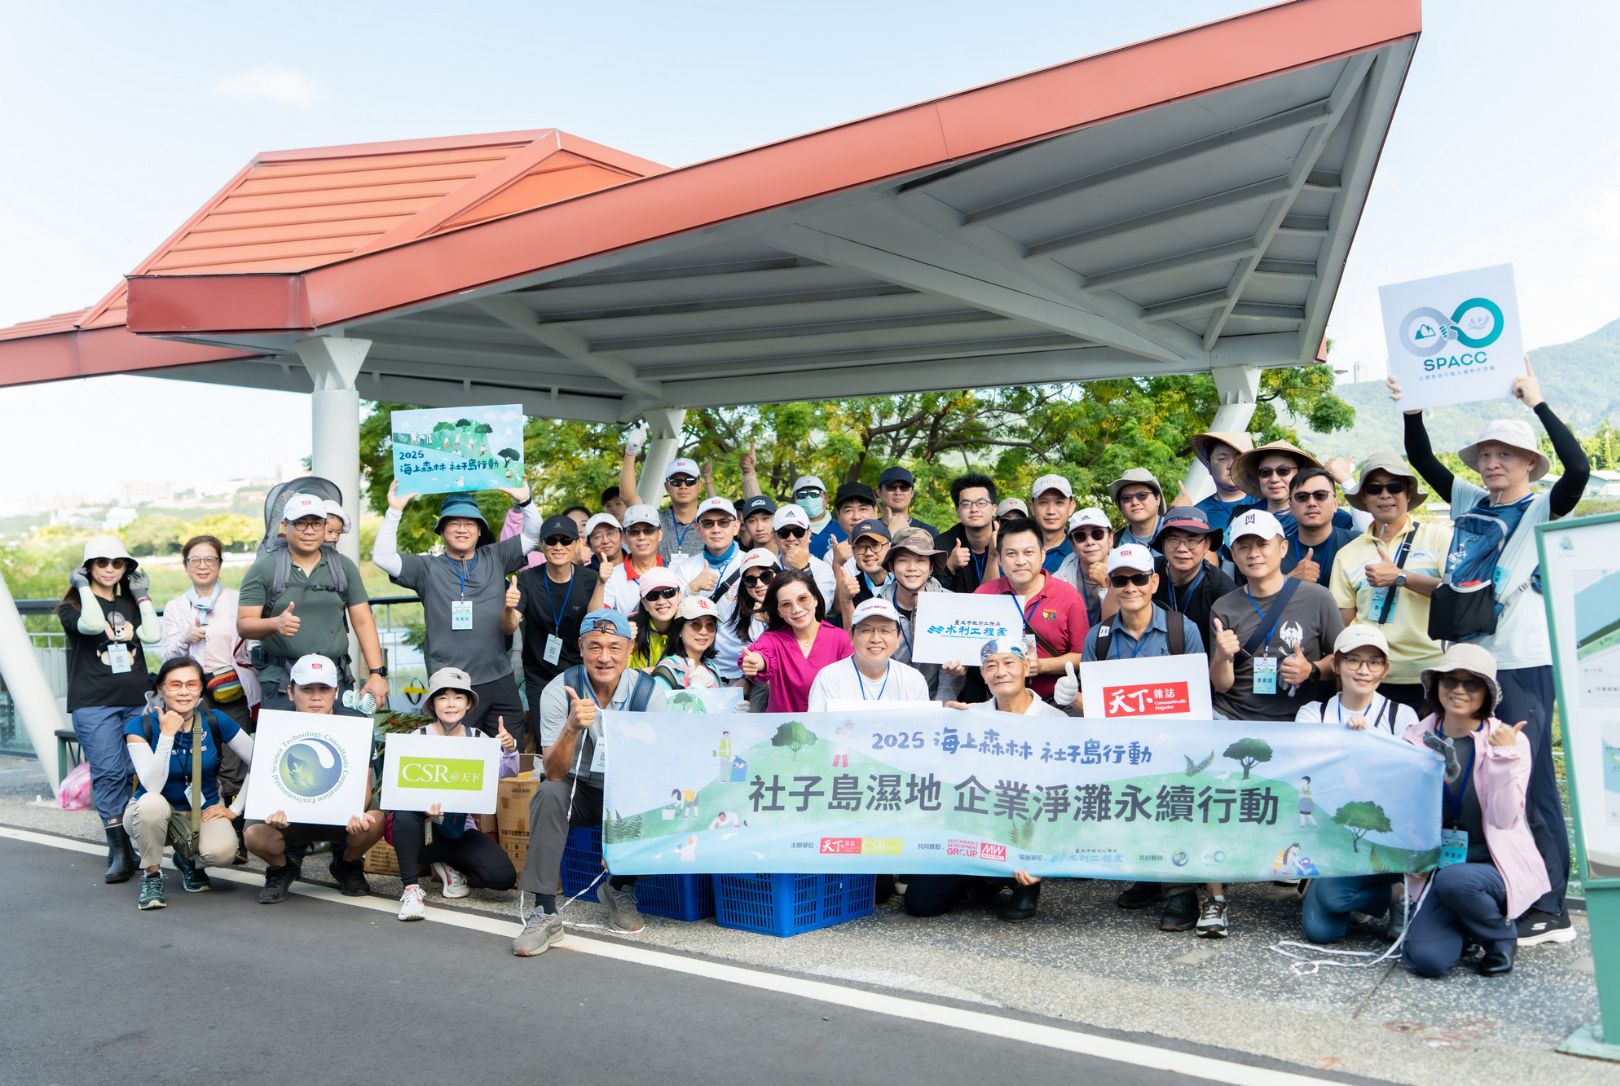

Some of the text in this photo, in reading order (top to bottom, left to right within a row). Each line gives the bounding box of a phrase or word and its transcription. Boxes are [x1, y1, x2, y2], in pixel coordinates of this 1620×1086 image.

[1423, 351, 1488, 372] SPACC
[399, 451, 425, 460] 2025
[399, 458, 499, 475] 海上森林 社子島行動
[1108, 687, 1176, 715] 天下 雜誌
[871, 726, 1153, 766] 2025 海上森林 社子島行動
[748, 773, 1280, 827] 社子島濕地 企業淨灘永續行動
